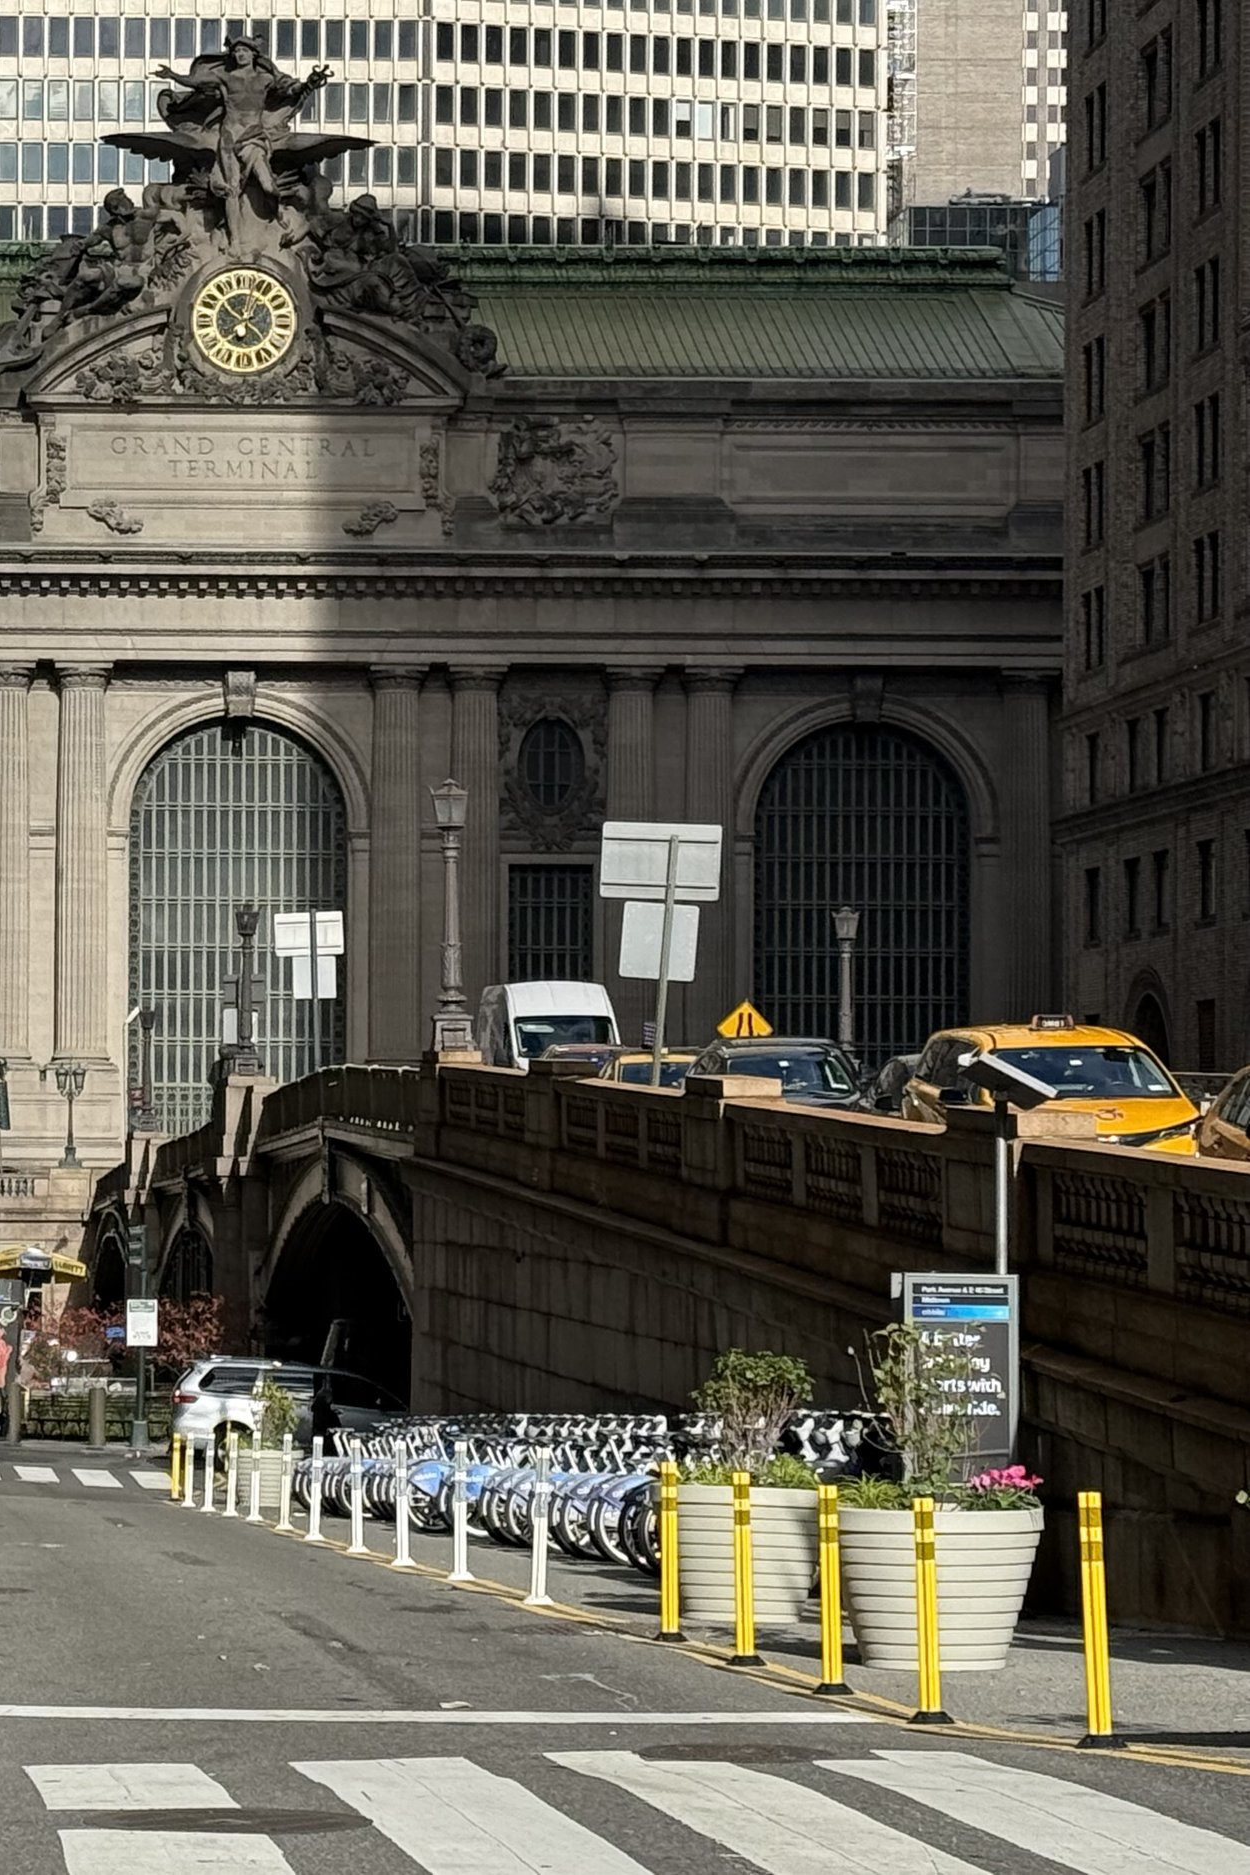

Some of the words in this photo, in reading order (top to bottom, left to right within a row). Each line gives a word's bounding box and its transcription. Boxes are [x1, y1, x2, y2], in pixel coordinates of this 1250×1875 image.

[110, 436, 215, 456] GRAND
[237, 437, 377, 457] CENTRAL
[167, 459, 320, 480] TERMINAL
[934, 1331, 981, 1347] btter
[967, 1378, 1002, 1392] with
